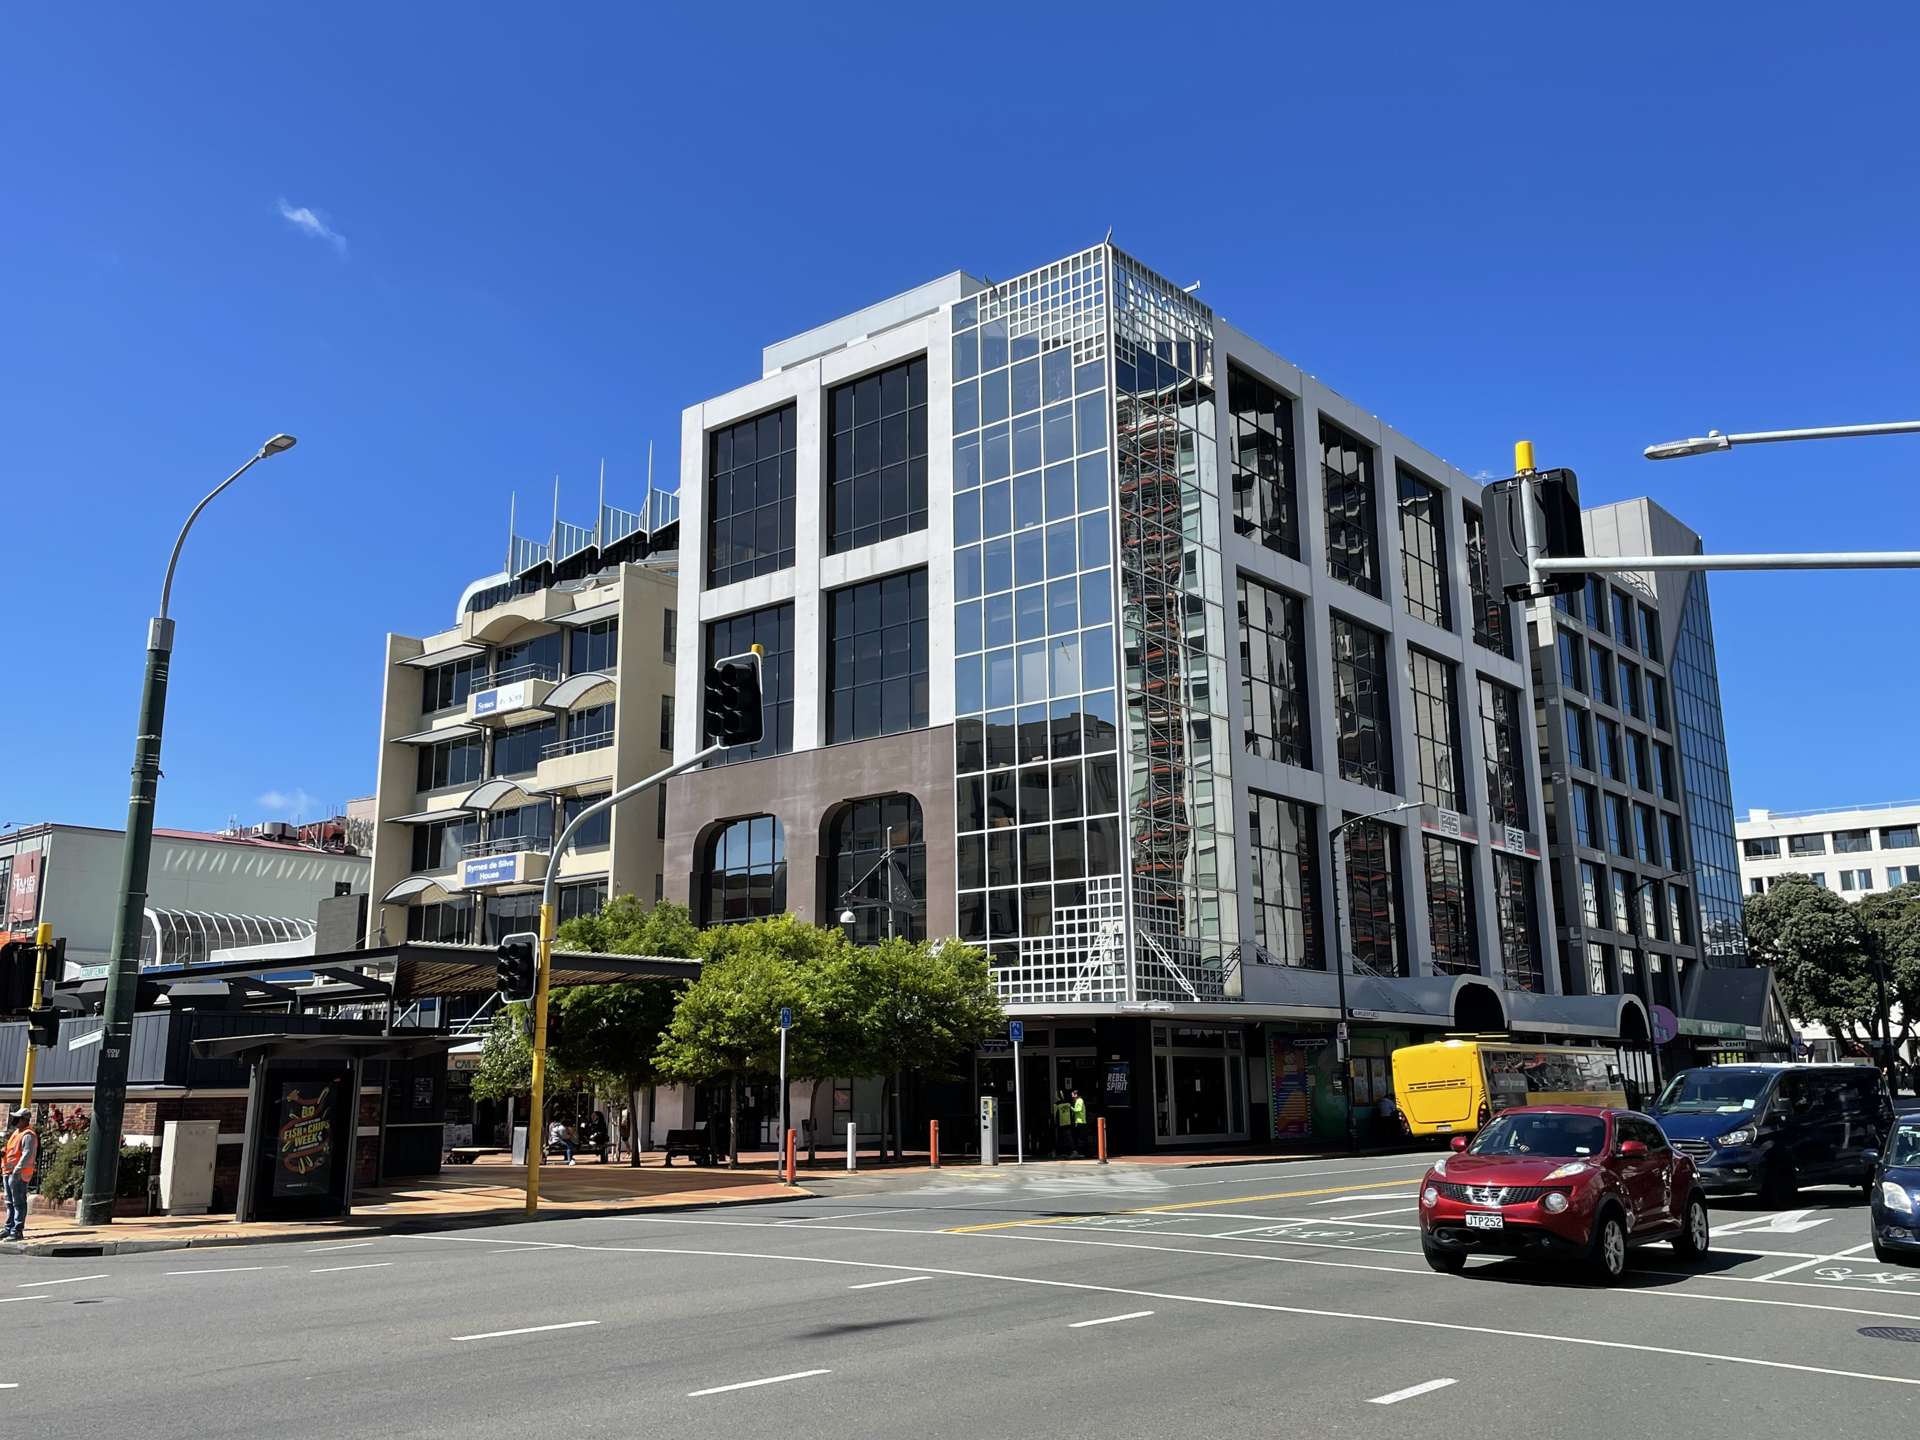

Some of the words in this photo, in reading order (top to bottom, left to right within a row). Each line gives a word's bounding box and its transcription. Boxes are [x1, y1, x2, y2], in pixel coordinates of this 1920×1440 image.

[467, 863, 488, 873] Symes
[498, 859, 514, 868] Silva
[480, 872, 499, 880] House
[1107, 1073, 1127, 1081] REBEL
[1107, 1082, 1128, 1091] SPIRIT
[284, 1128, 302, 1140] FISH
[308, 1121, 330, 1133] CHIPS
[295, 1134, 318, 1146] WEEK
[1467, 1216, 1502, 1227] JTP252
